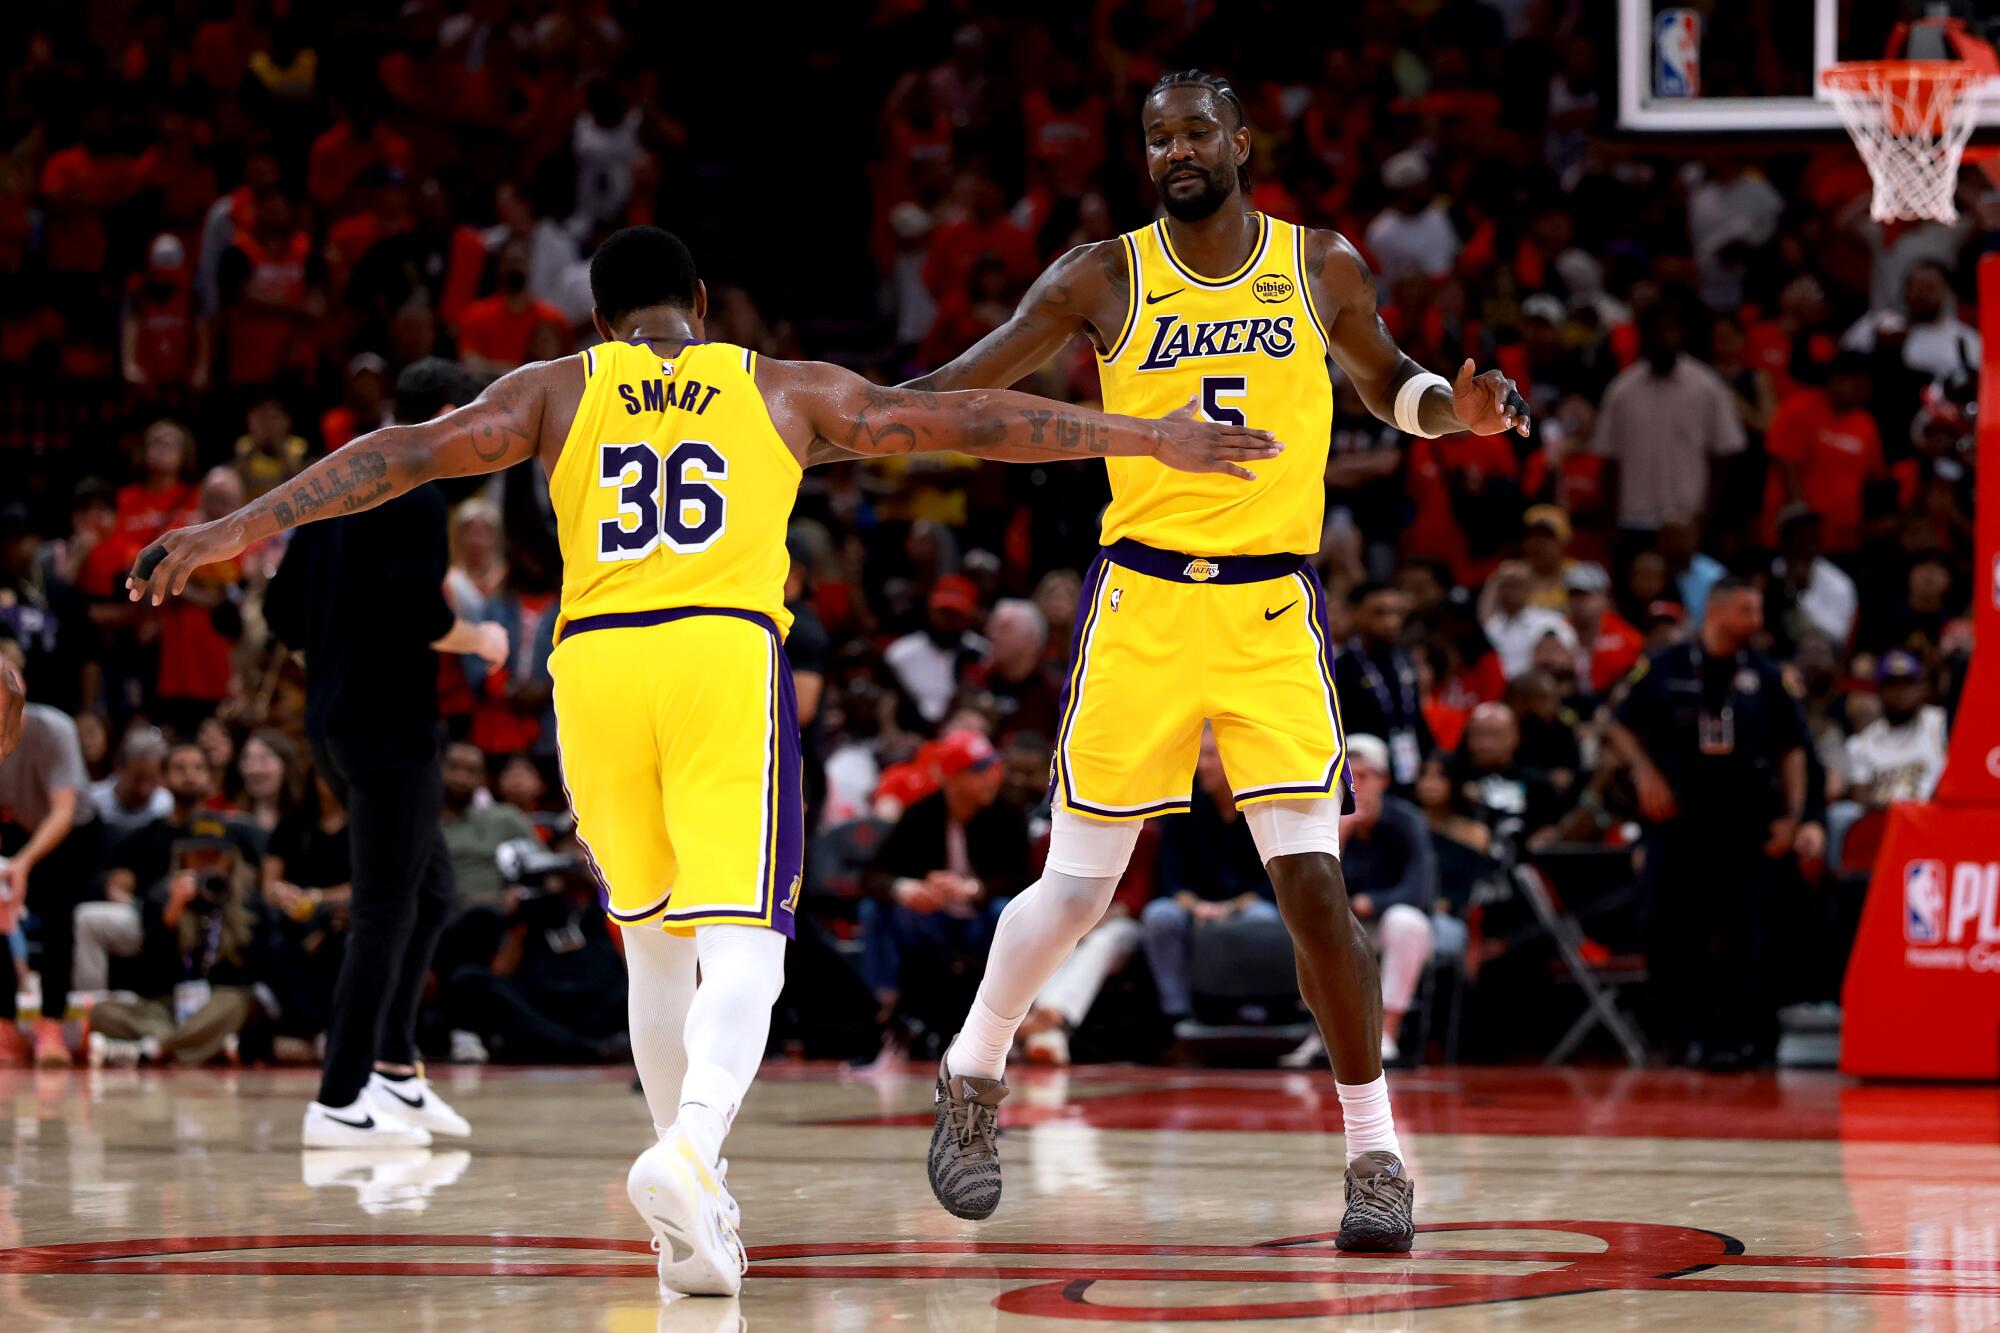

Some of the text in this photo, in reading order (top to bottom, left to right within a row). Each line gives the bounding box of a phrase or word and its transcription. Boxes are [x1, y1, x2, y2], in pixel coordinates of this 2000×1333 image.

[1256, 281, 1291, 294] bibigo
[1136, 314, 1297, 372] LAKERS
[618, 379, 722, 415] SMART
[1200, 375, 1248, 428] 5
[597, 439, 729, 562] 36
